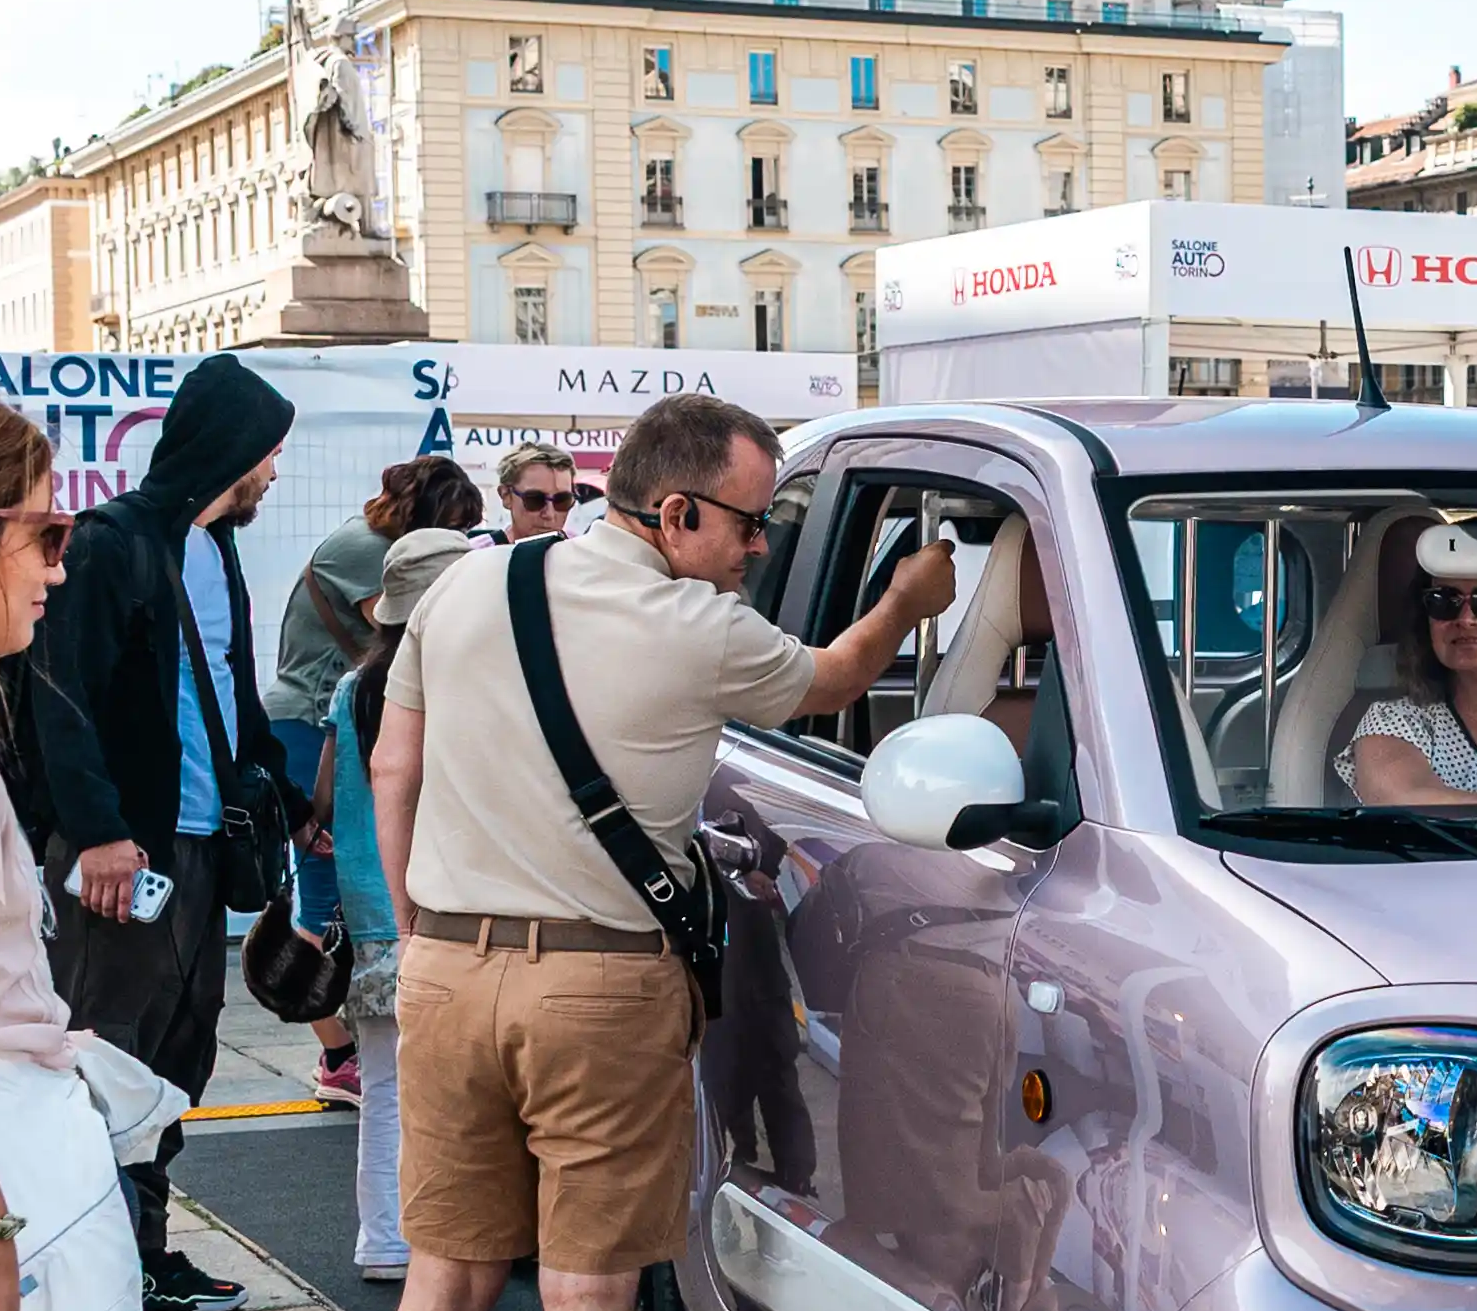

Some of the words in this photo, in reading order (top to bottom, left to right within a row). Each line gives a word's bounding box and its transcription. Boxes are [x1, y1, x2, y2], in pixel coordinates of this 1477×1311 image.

[1171, 238, 1219, 252] SALONE
[1171, 251, 1225, 277] AUTO
[1171, 264, 1225, 278] TORINO
[972, 261, 1058, 298] HONDA
[558, 368, 717, 395] MAZDA
[465, 427, 541, 446] AUTO
[551, 427, 626, 447] TORIN
